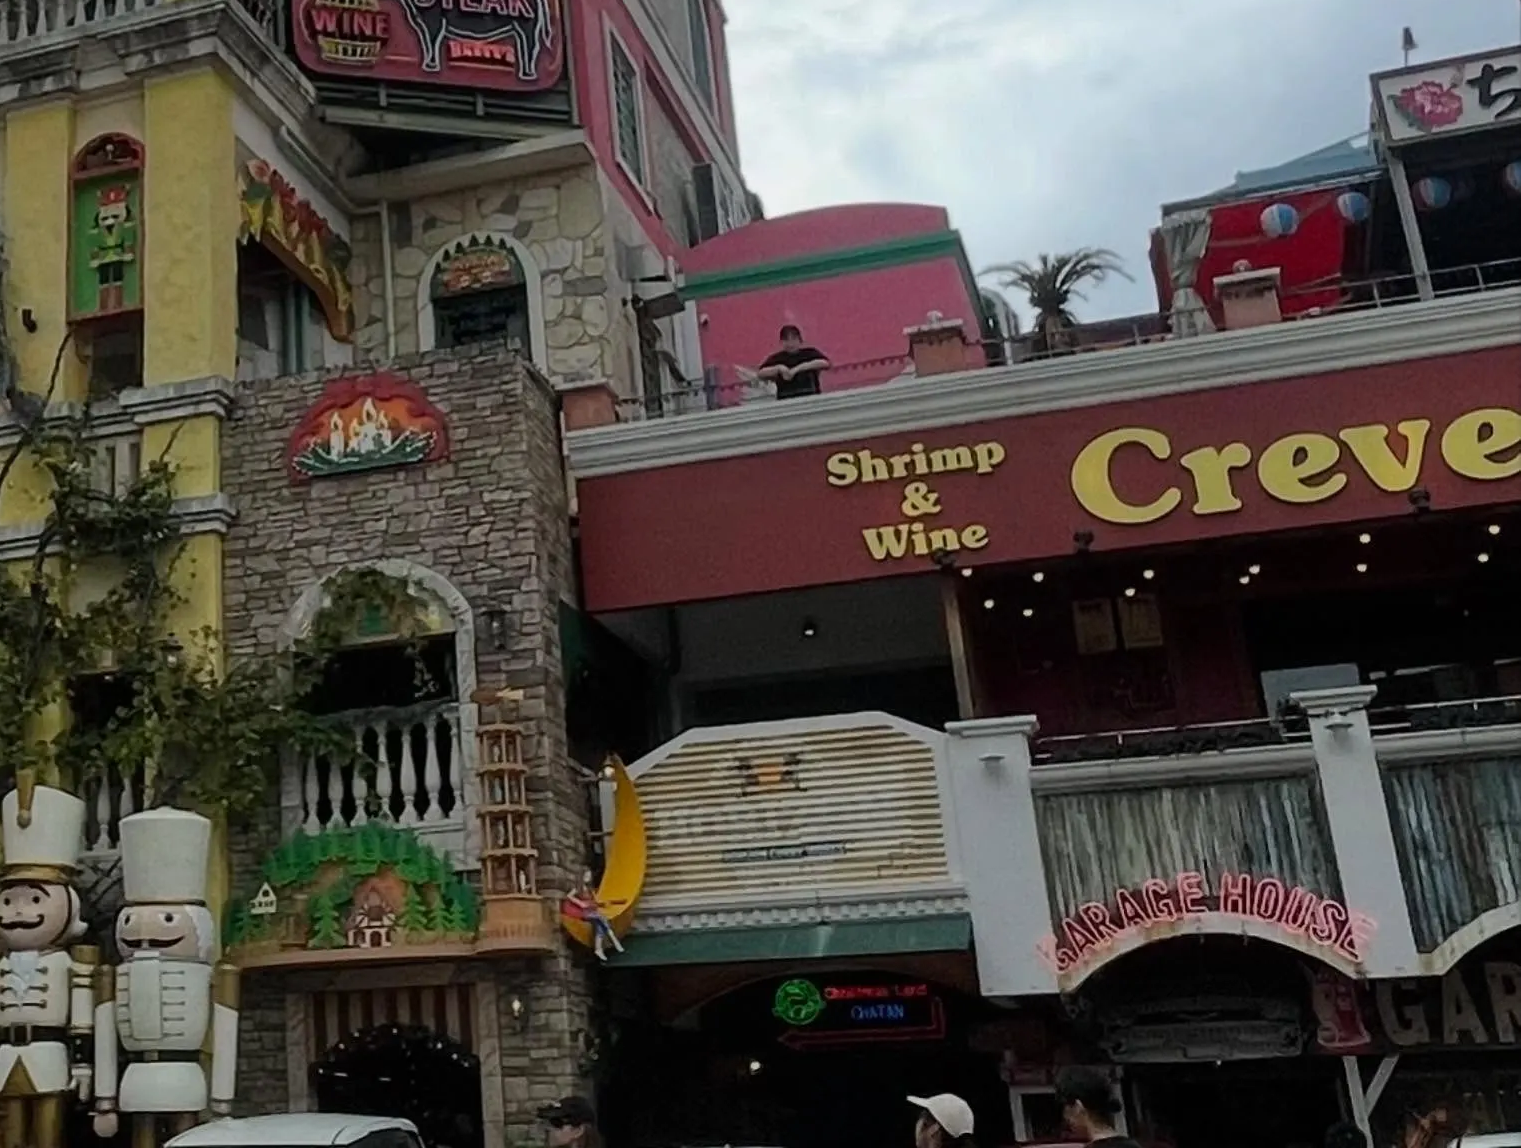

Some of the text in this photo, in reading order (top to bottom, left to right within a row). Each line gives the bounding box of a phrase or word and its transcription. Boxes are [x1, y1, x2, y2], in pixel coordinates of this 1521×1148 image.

[309, 8, 390, 39] WINE
[826, 441, 1007, 486] Shrimp
[1070, 407, 1521, 524] Creve
[900, 480, 943, 518] &
[861, 521, 990, 561] Wine
[1037, 870, 1378, 974] GARAGE HOUSE
